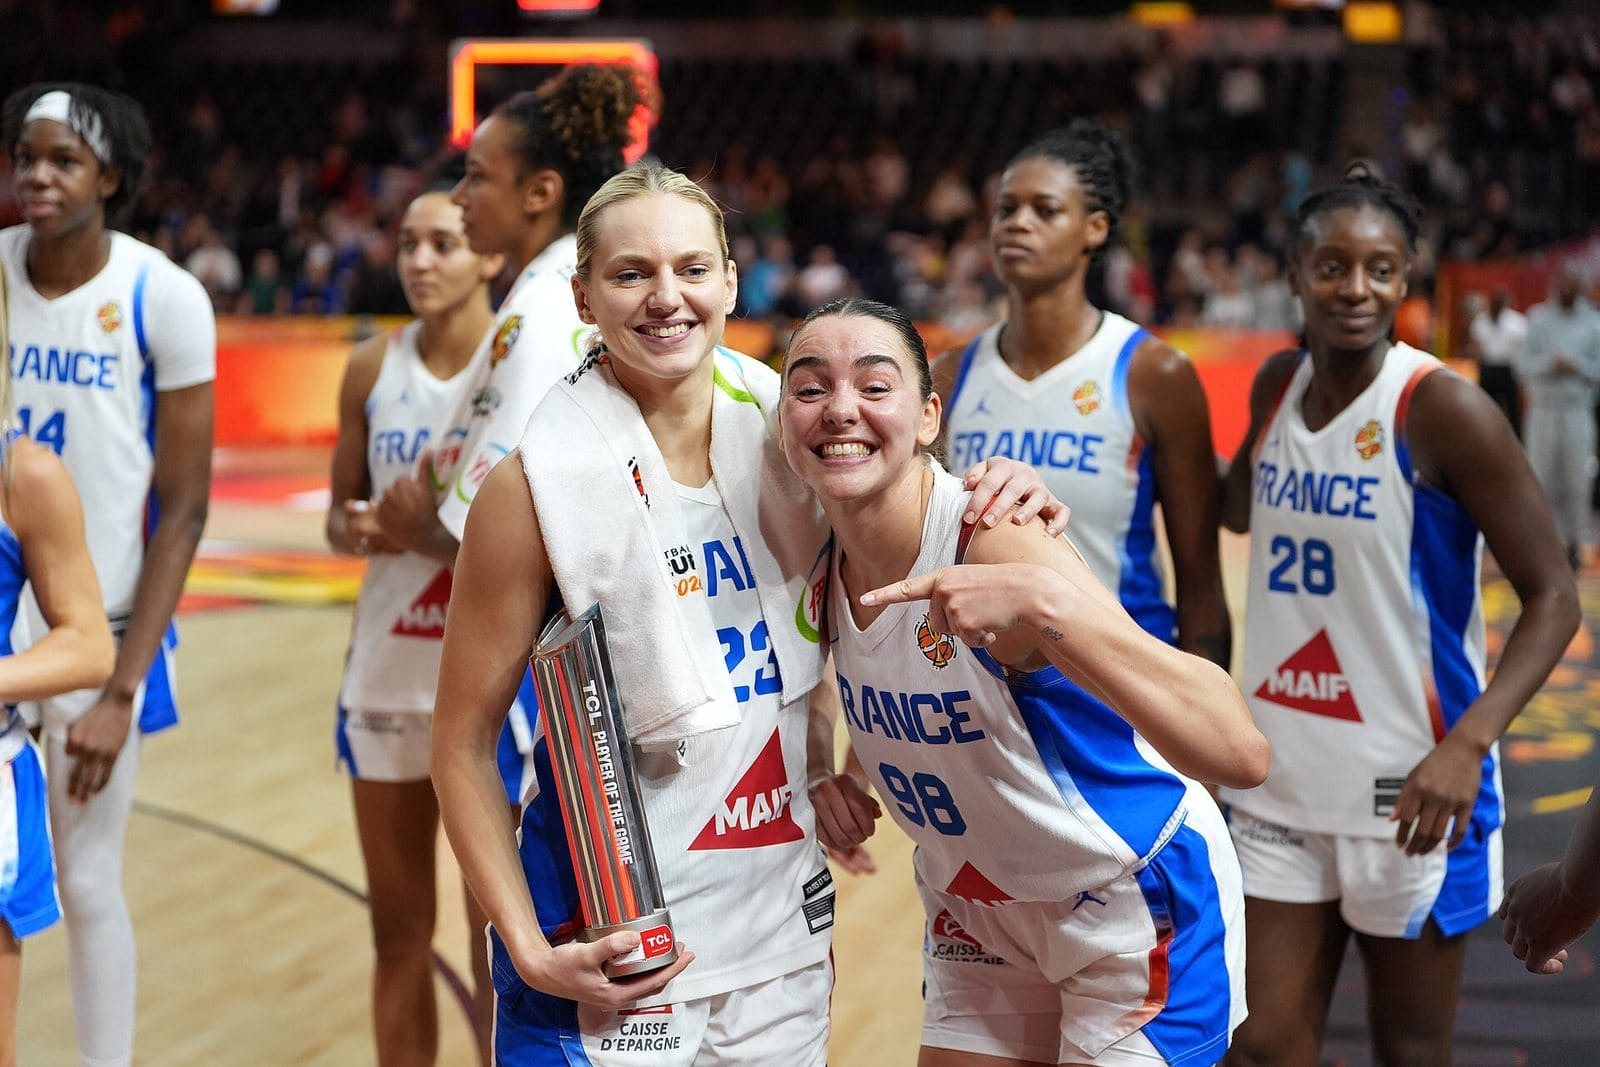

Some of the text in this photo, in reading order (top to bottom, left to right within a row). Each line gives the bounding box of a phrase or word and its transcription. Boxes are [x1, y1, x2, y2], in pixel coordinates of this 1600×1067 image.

[953, 430, 1105, 474] FRANCE
[1257, 461, 1380, 519] FRANCE
[1268, 535, 1336, 596] 28
[716, 619, 784, 703] 23
[1266, 668, 1351, 702] MAIF
[582, 679, 634, 866] TCL PLAYER OF THE GAME
[878, 761, 967, 837] 98
[714, 783, 793, 836] MAIF
[646, 933, 671, 947] TCL
[600, 1036, 681, 1052] D'EPARGNE
[619, 1022, 669, 1036] CAISSE
